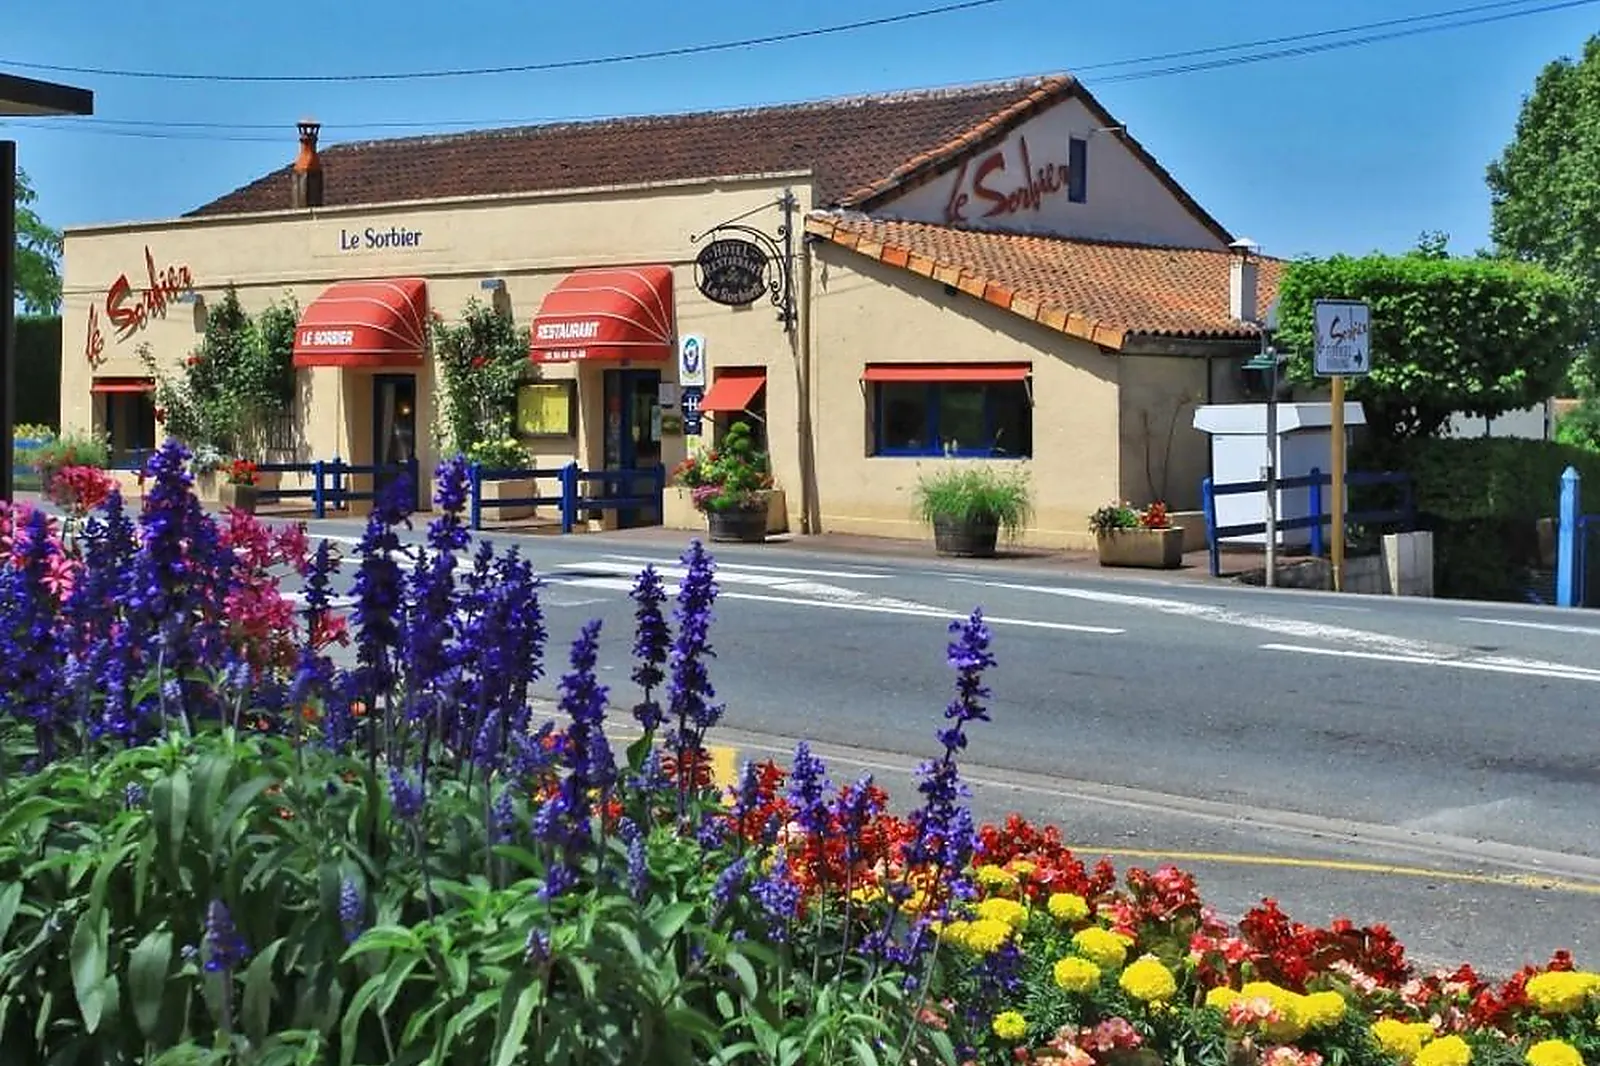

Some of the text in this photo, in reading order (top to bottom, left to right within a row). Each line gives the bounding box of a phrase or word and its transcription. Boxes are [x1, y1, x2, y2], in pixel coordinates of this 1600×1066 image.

[341, 227, 423, 250] Le Sorbier
[106, 244, 193, 344] Sorbier
[301, 330, 354, 346] LE SORBIER
[536, 321, 600, 339] RESTAURANT
